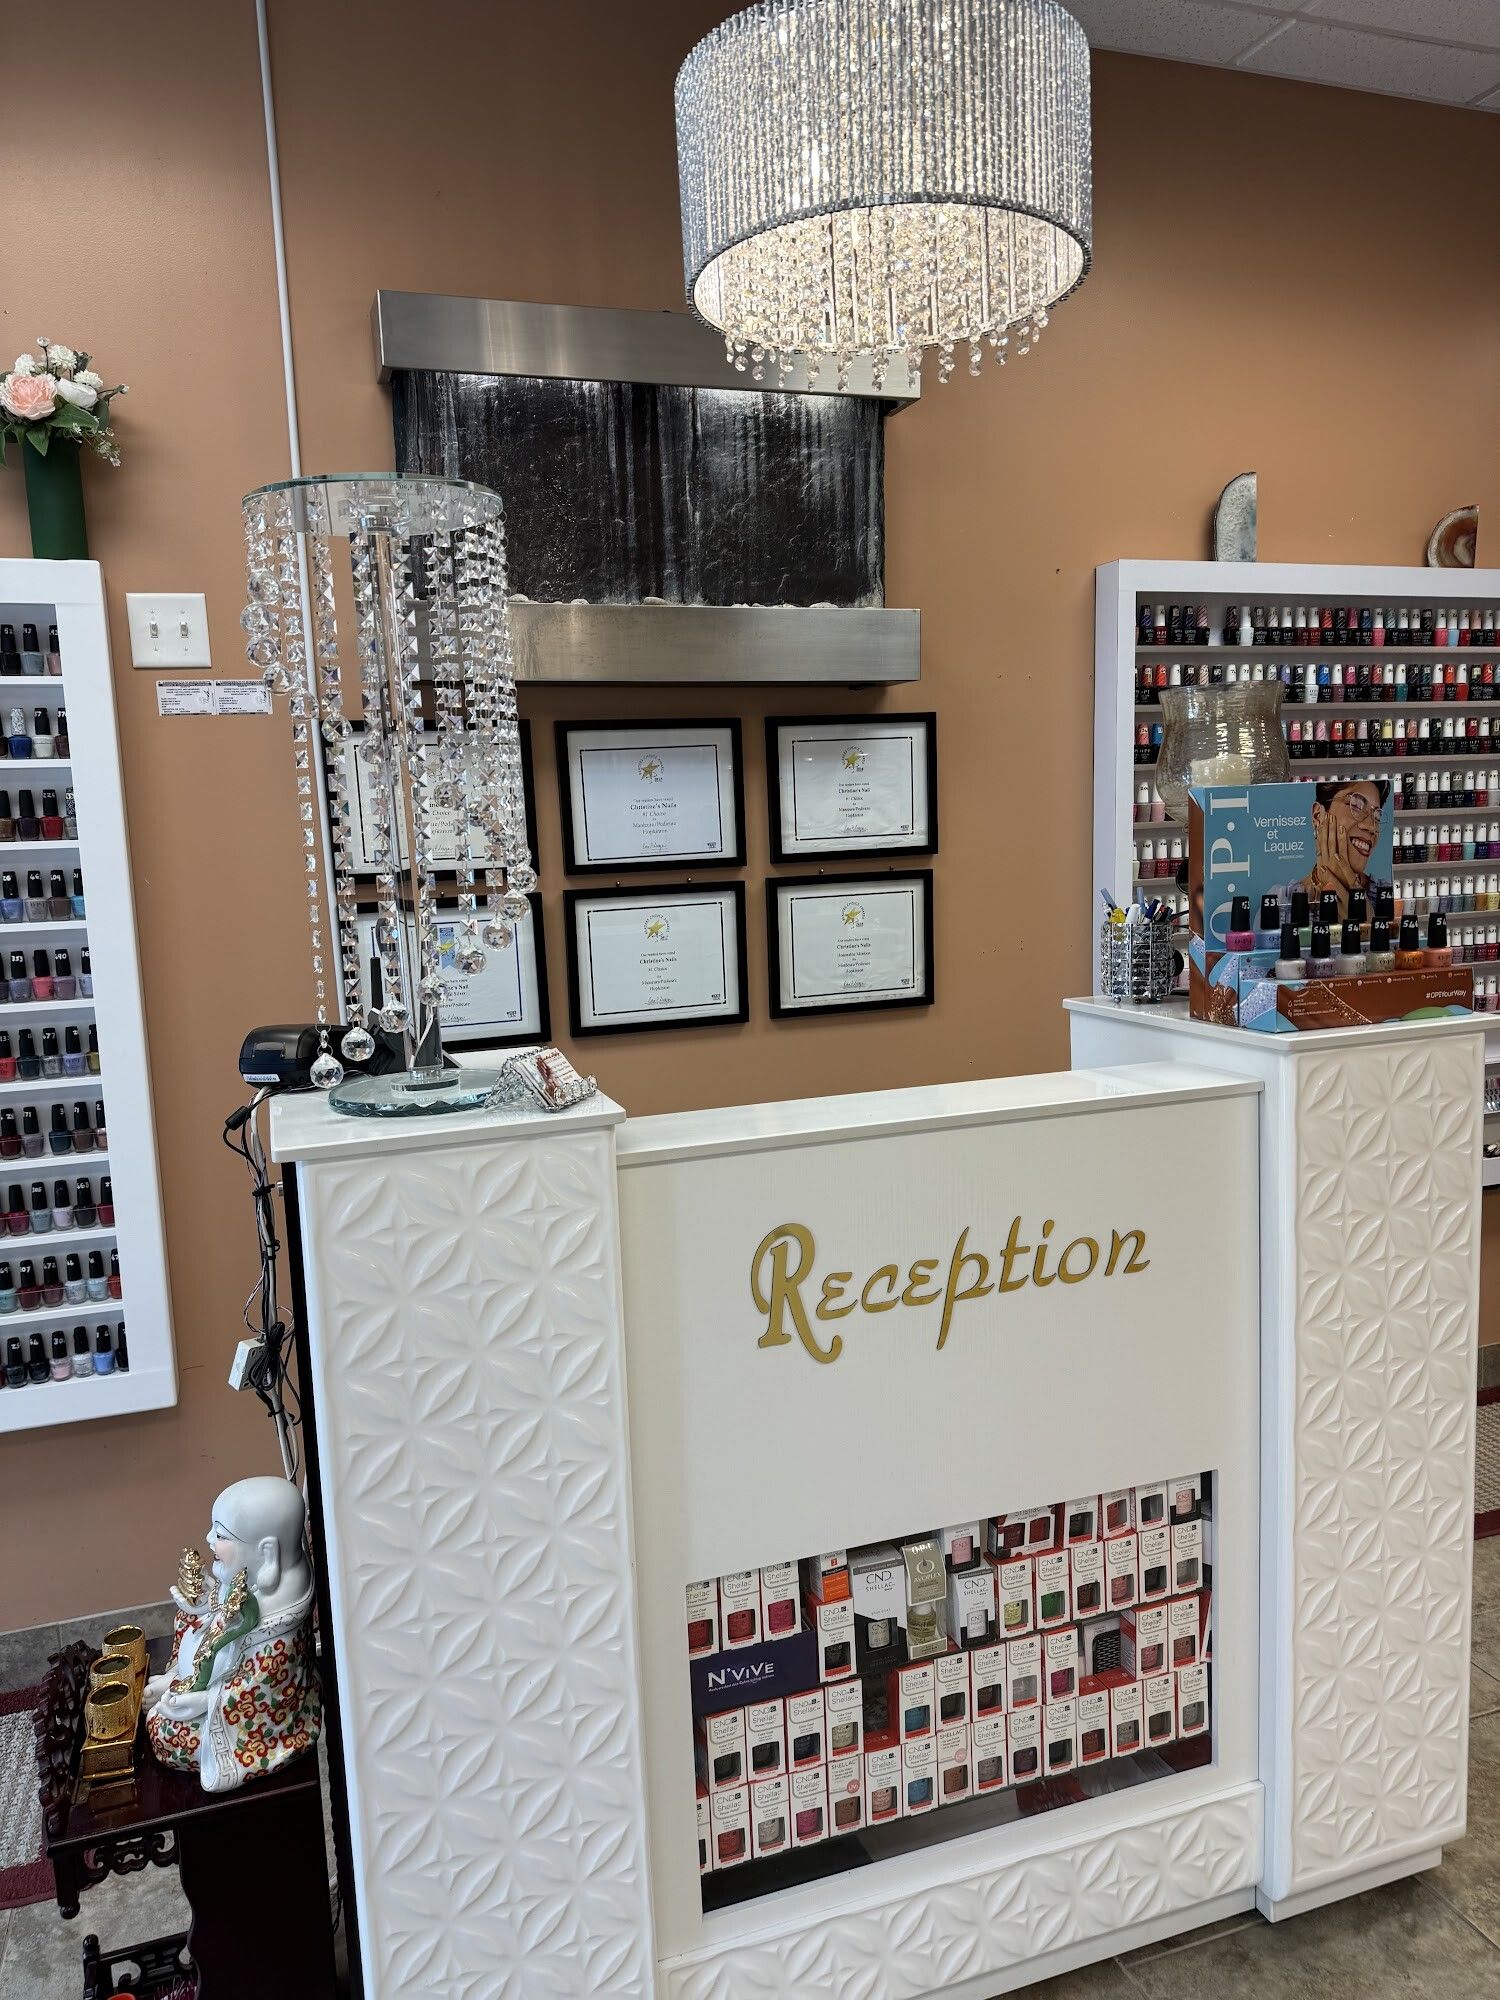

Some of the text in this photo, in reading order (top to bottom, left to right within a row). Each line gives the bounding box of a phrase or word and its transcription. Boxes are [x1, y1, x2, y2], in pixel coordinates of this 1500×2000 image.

[1253, 815, 1307, 828] Vernissez
[1267, 829, 1279, 840] et
[1264, 841, 1305, 854] Laquez
[751, 1215, 1151, 1364] Reception
[866, 1570, 892, 1584] CND
[866, 1582, 893, 1592] SHELLAC
[964, 1578, 986, 1590] CND
[964, 1588, 987, 1596] SHELLAC
[940, 1728, 964, 1739] SHELLAC
[831, 1760, 856, 1770] SHELLAC
